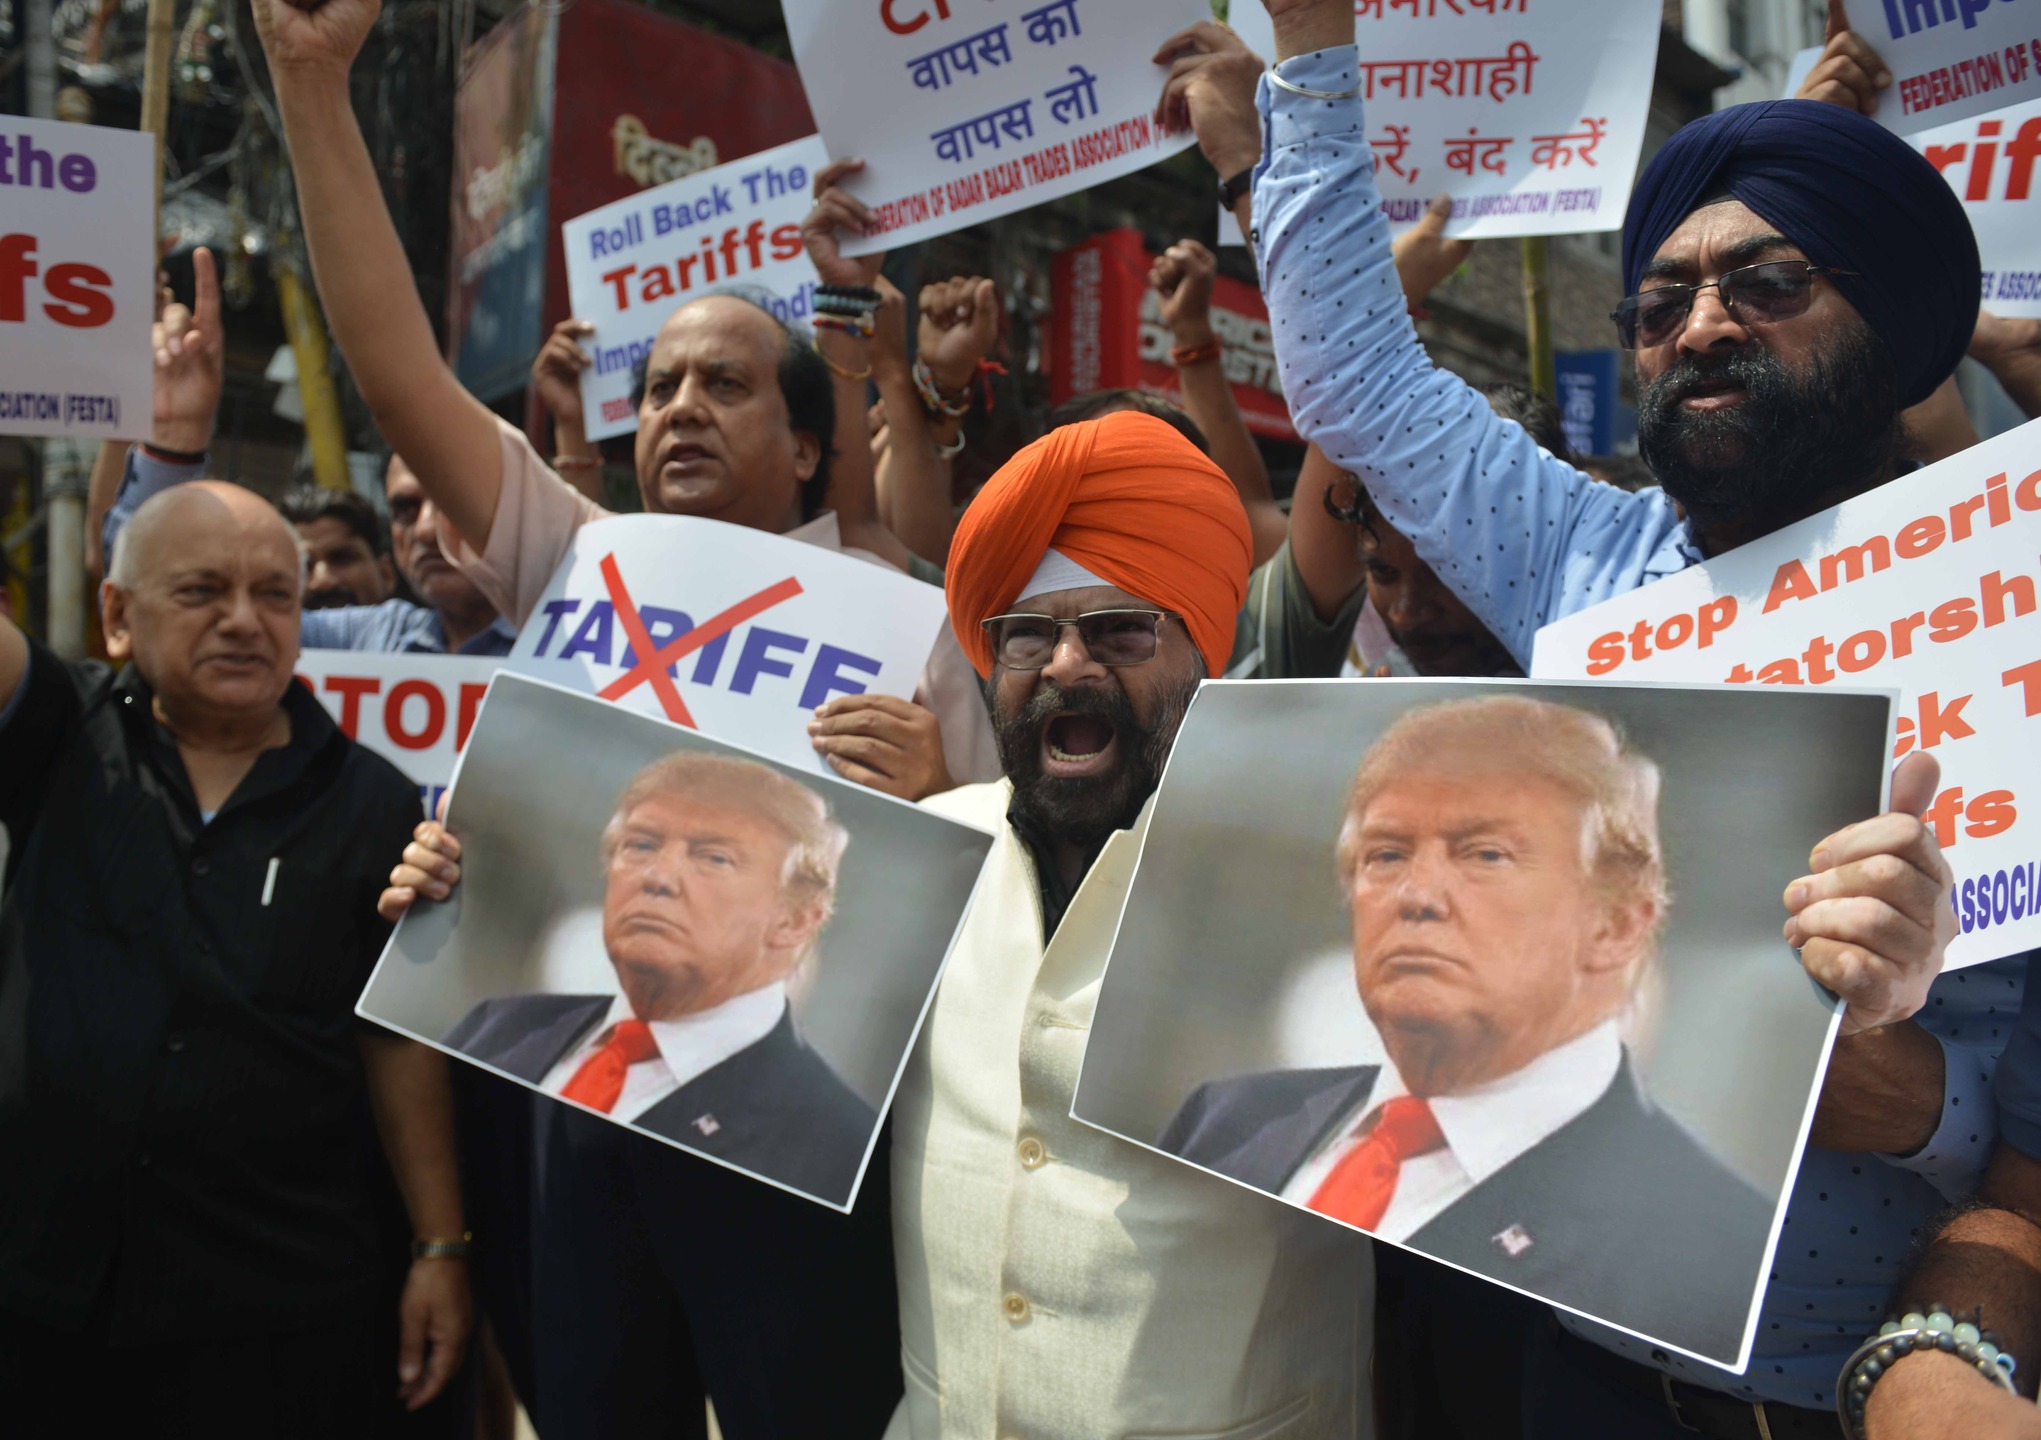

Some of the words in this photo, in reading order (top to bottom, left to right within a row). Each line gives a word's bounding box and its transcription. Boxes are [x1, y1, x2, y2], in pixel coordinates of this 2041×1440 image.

[906, 22, 1012, 91] वापस
[1899, 51, 2006, 116] FEDERATION
[2005, 43, 2029, 83] OF
[930, 99, 1034, 163] वापस
[1045, 64, 1099, 125] लो
[1443, 127, 1514, 176] बंद
[1531, 116, 1608, 170] करें
[588, 211, 643, 260] Roll
[652, 183, 734, 238] Back
[741, 164, 808, 205] The
[929, 185, 945, 218] OF
[945, 172, 986, 213] SADAR
[983, 158, 1025, 200] BAZAR
[1022, 142, 1072, 187] TRADES
[1070, 113, 1152, 172] ASSOCIATION
[602, 218, 804, 312] Tariffs
[531, 597, 884, 711] TARIFF
[1585, 594, 1738, 677] Stop
